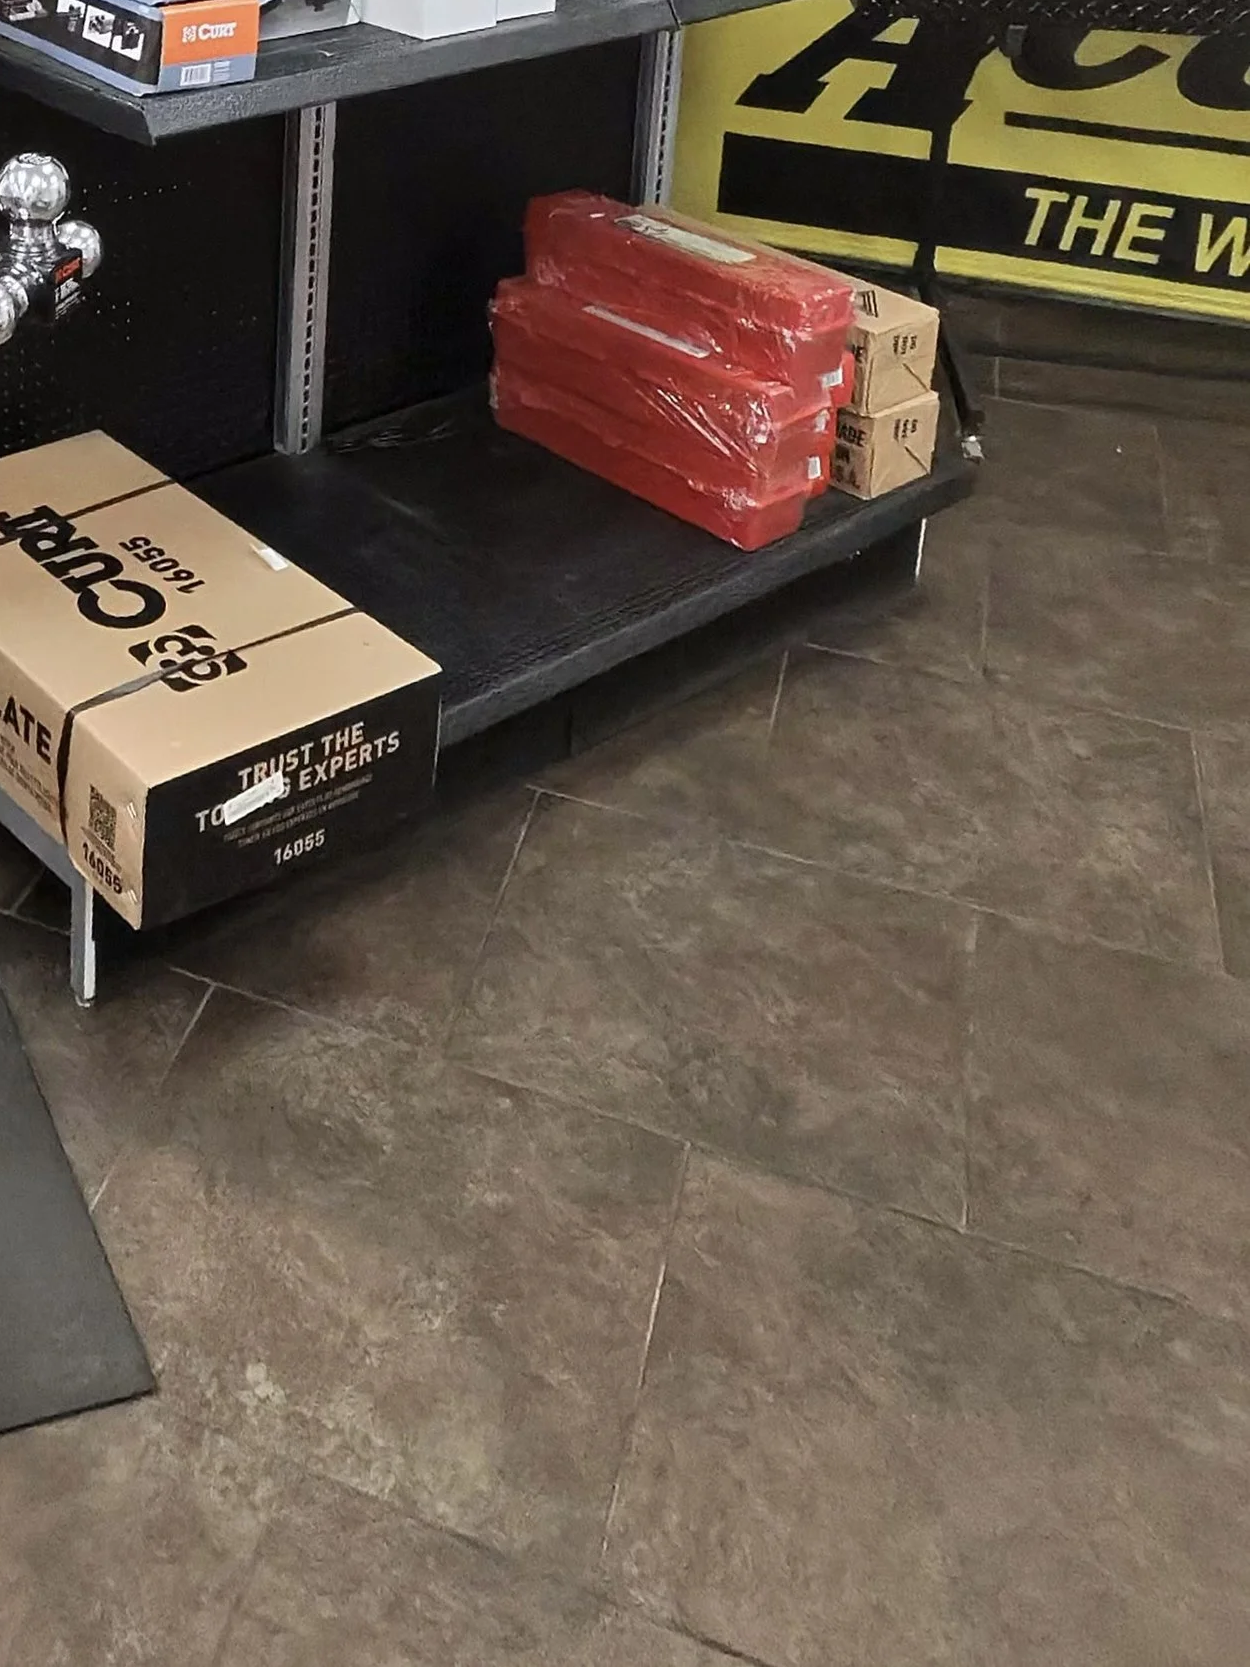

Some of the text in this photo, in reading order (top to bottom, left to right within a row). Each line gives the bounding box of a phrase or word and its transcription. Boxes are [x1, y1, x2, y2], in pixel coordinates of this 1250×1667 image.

[197, 22, 237, 40] CURT
[1024, 187, 1176, 265] THE
[117, 536, 206, 594] 16055
[237, 721, 366, 792] TRUST THE
[298, 730, 401, 792] EXPERTS
[81, 840, 124, 896] 16055
[273, 828, 327, 866] 16055
